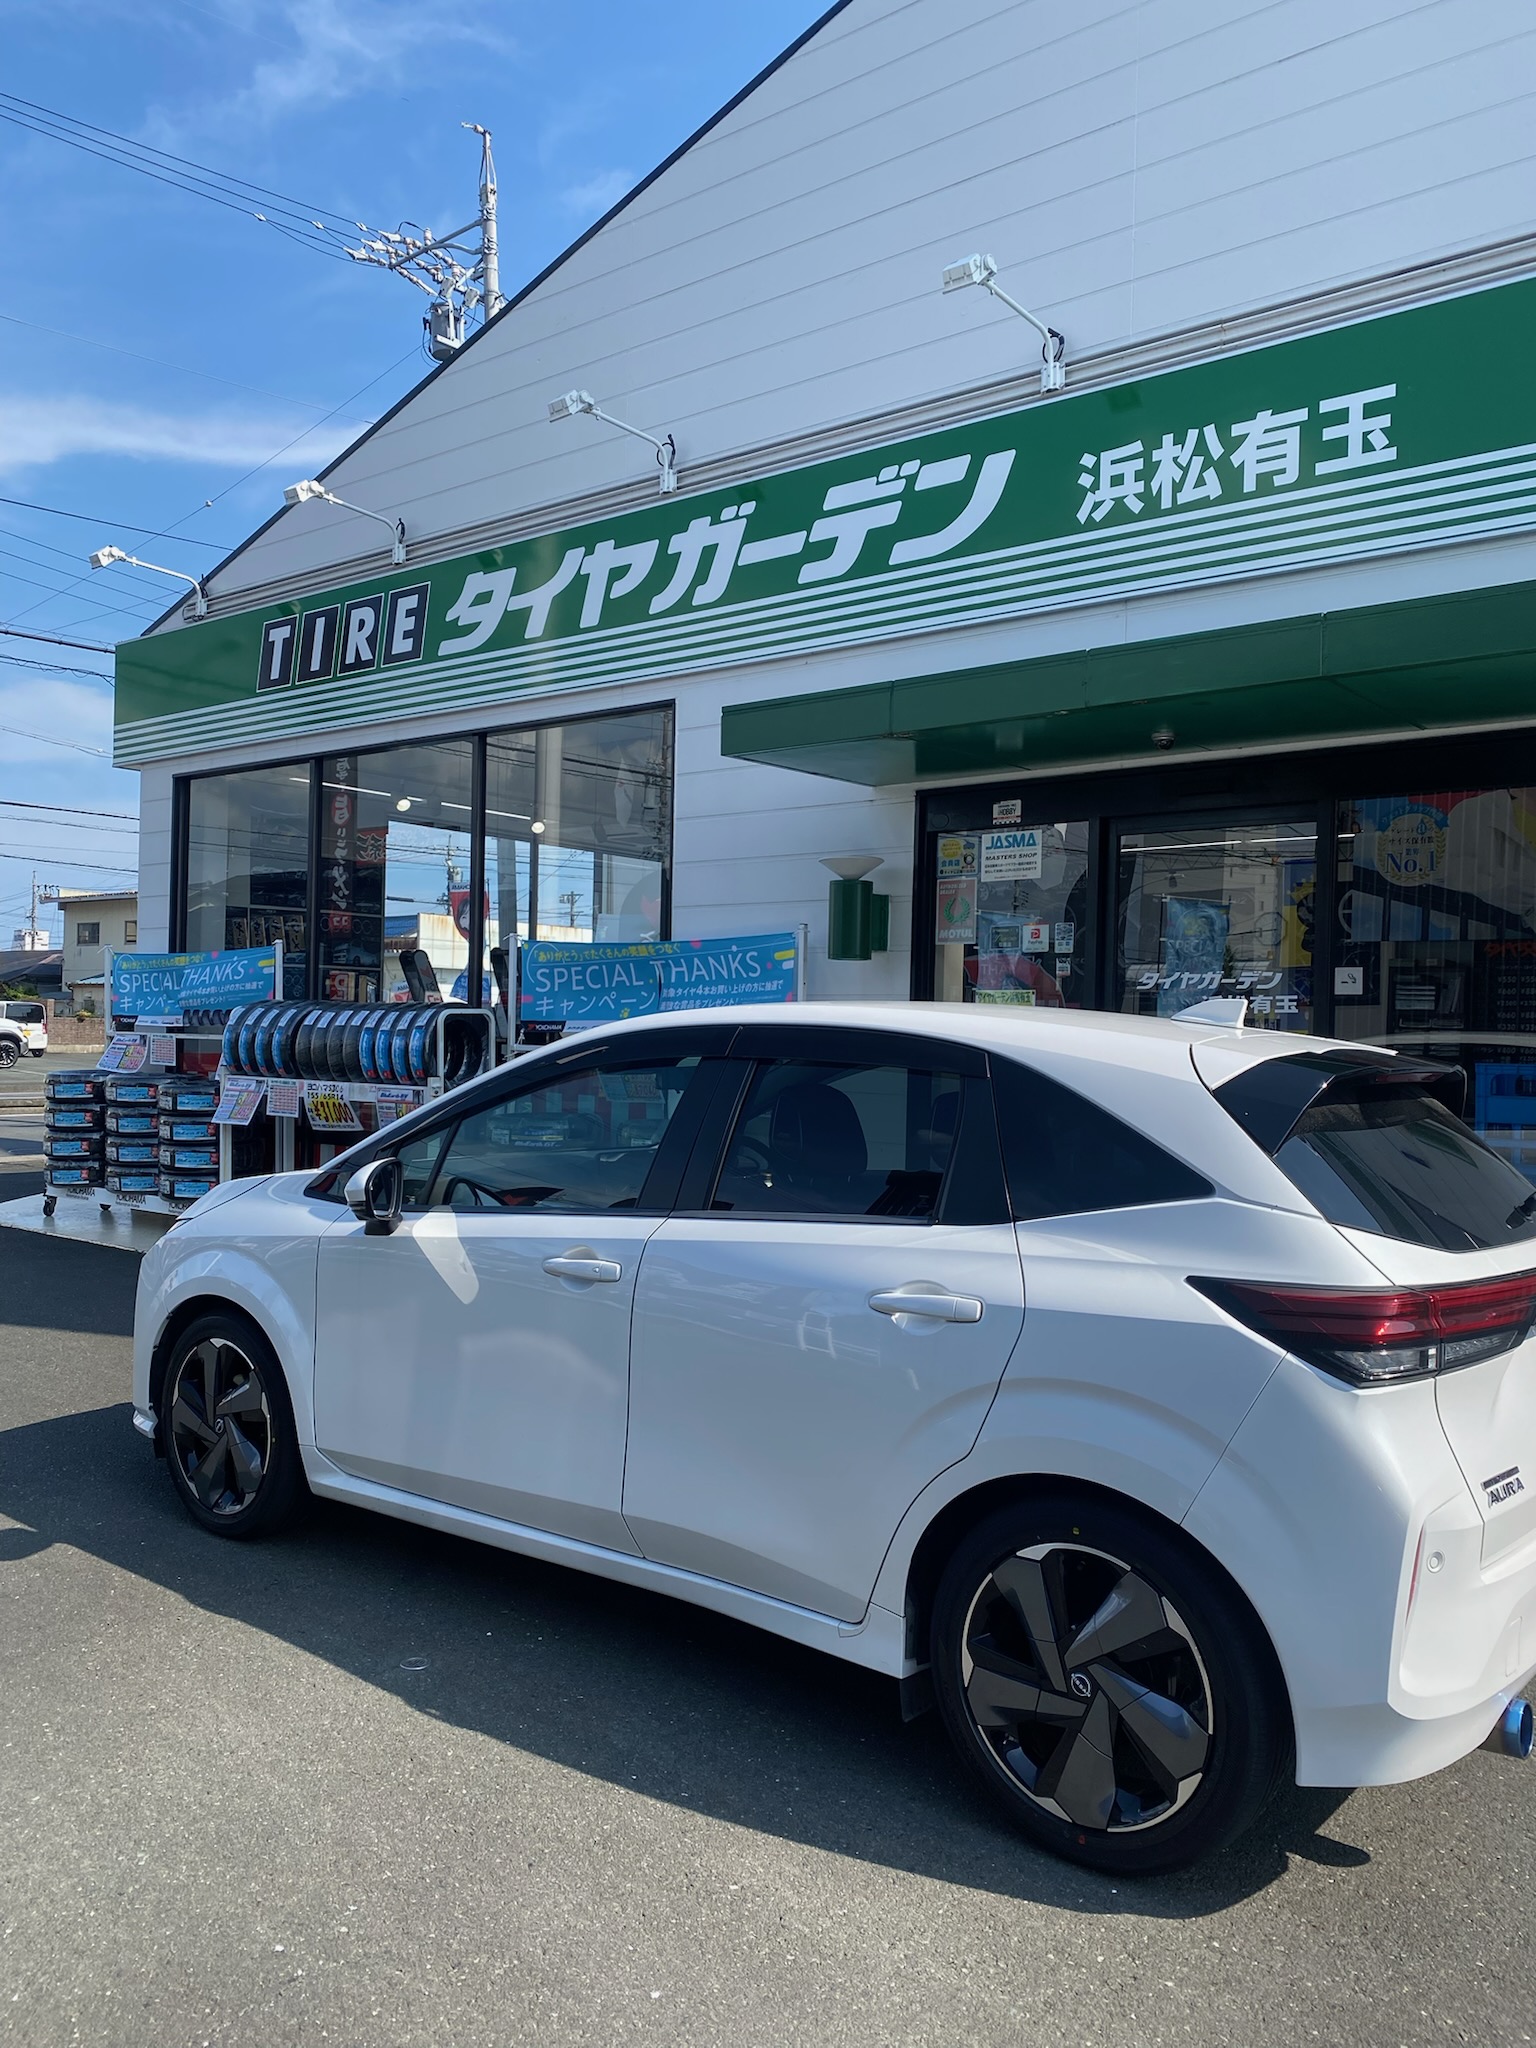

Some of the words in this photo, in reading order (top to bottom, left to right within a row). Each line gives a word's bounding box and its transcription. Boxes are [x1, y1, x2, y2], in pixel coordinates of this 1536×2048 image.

[1075, 383, 1398, 526] 浜松有玉
[438, 449, 1017, 657] タイヤガーデン
[266, 590, 424, 683] TIRE
[985, 832, 1037, 850] JASMA
[985, 854, 1017, 862] MASTERS
[1384, 849, 1438, 874] No.1
[939, 929, 974, 938] MOTUL
[119, 969, 181, 994] SPECIAL
[180, 960, 249, 988] THANKS
[535, 962, 645, 993] SPECIAL
[650, 951, 762, 984] THANKS
[1136, 970, 1283, 990] タイヤガーデン
[535, 991, 657, 1018] キャンペーン
[1487, 1476, 1525, 1509] AURA
